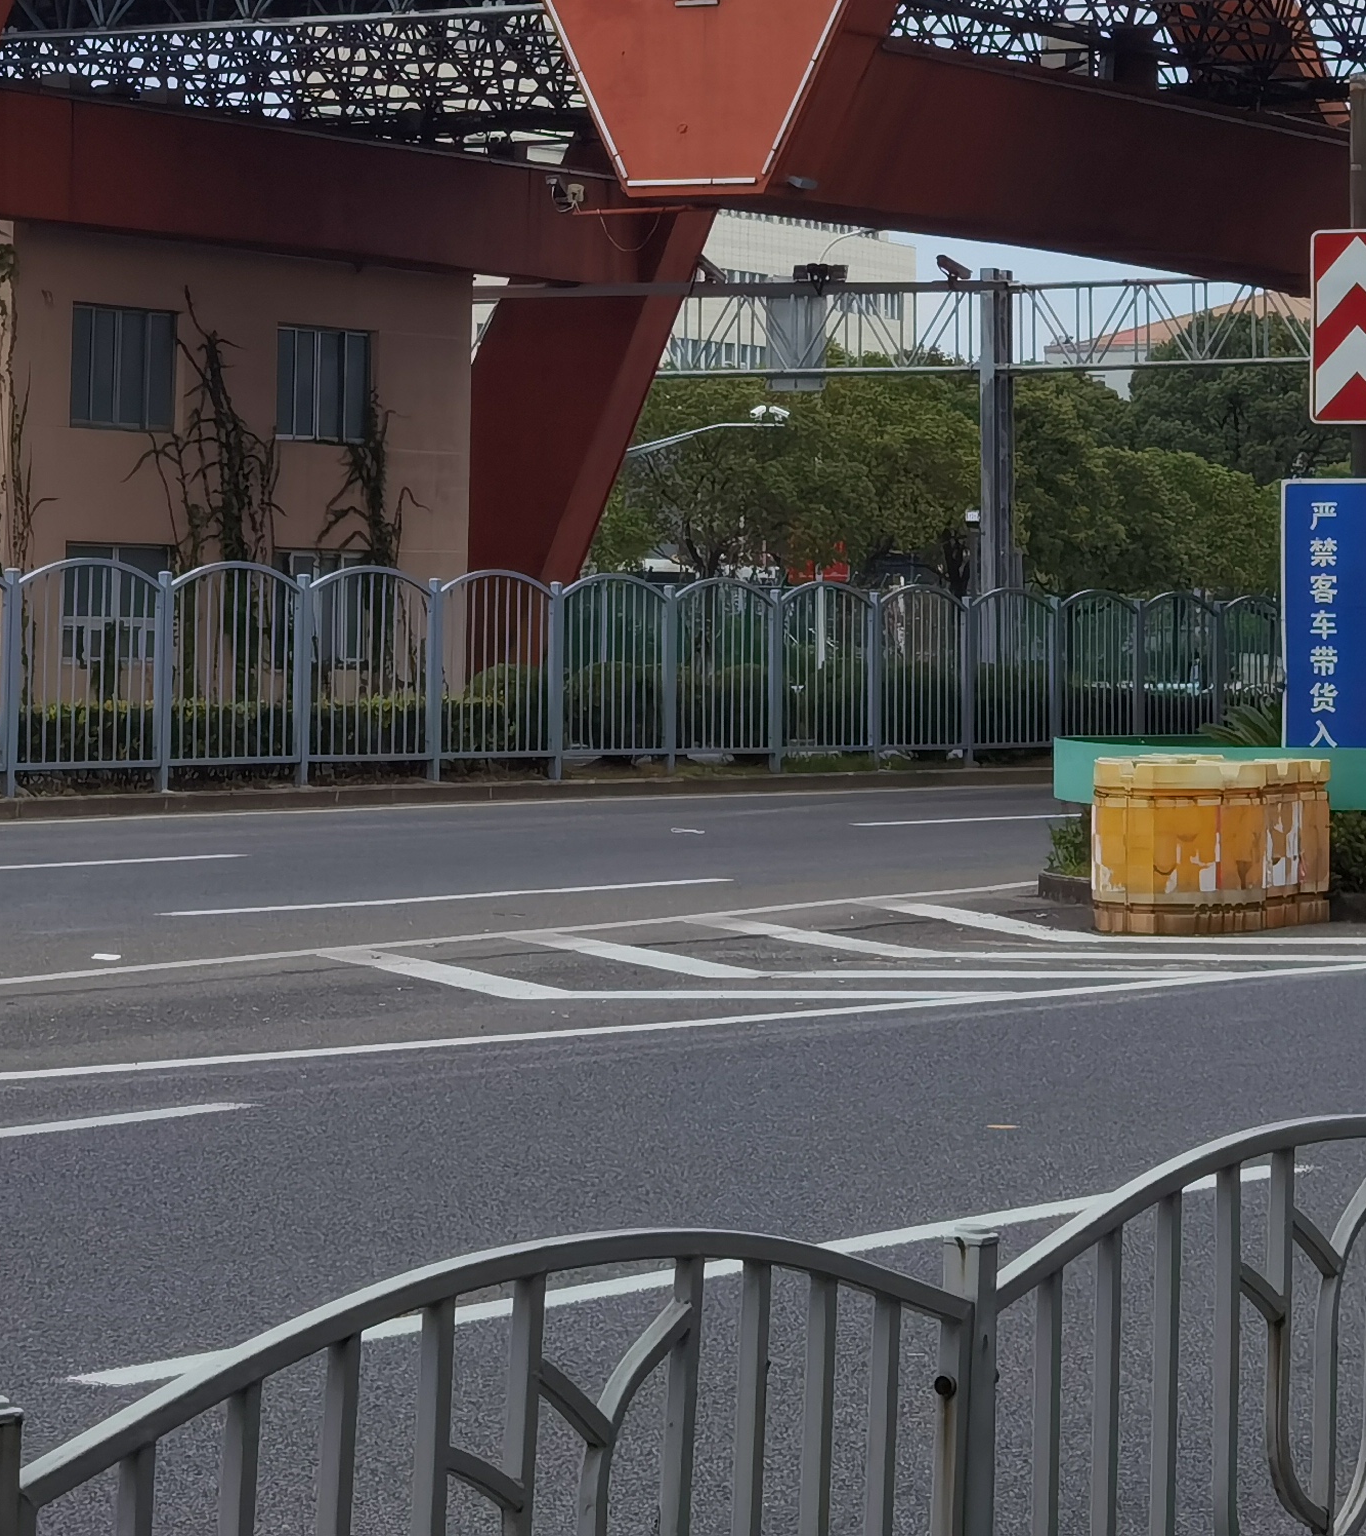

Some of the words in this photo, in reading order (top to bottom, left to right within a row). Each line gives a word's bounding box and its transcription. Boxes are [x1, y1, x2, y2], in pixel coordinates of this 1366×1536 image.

[1309, 501, 1339, 748] 严禁客车带货入
